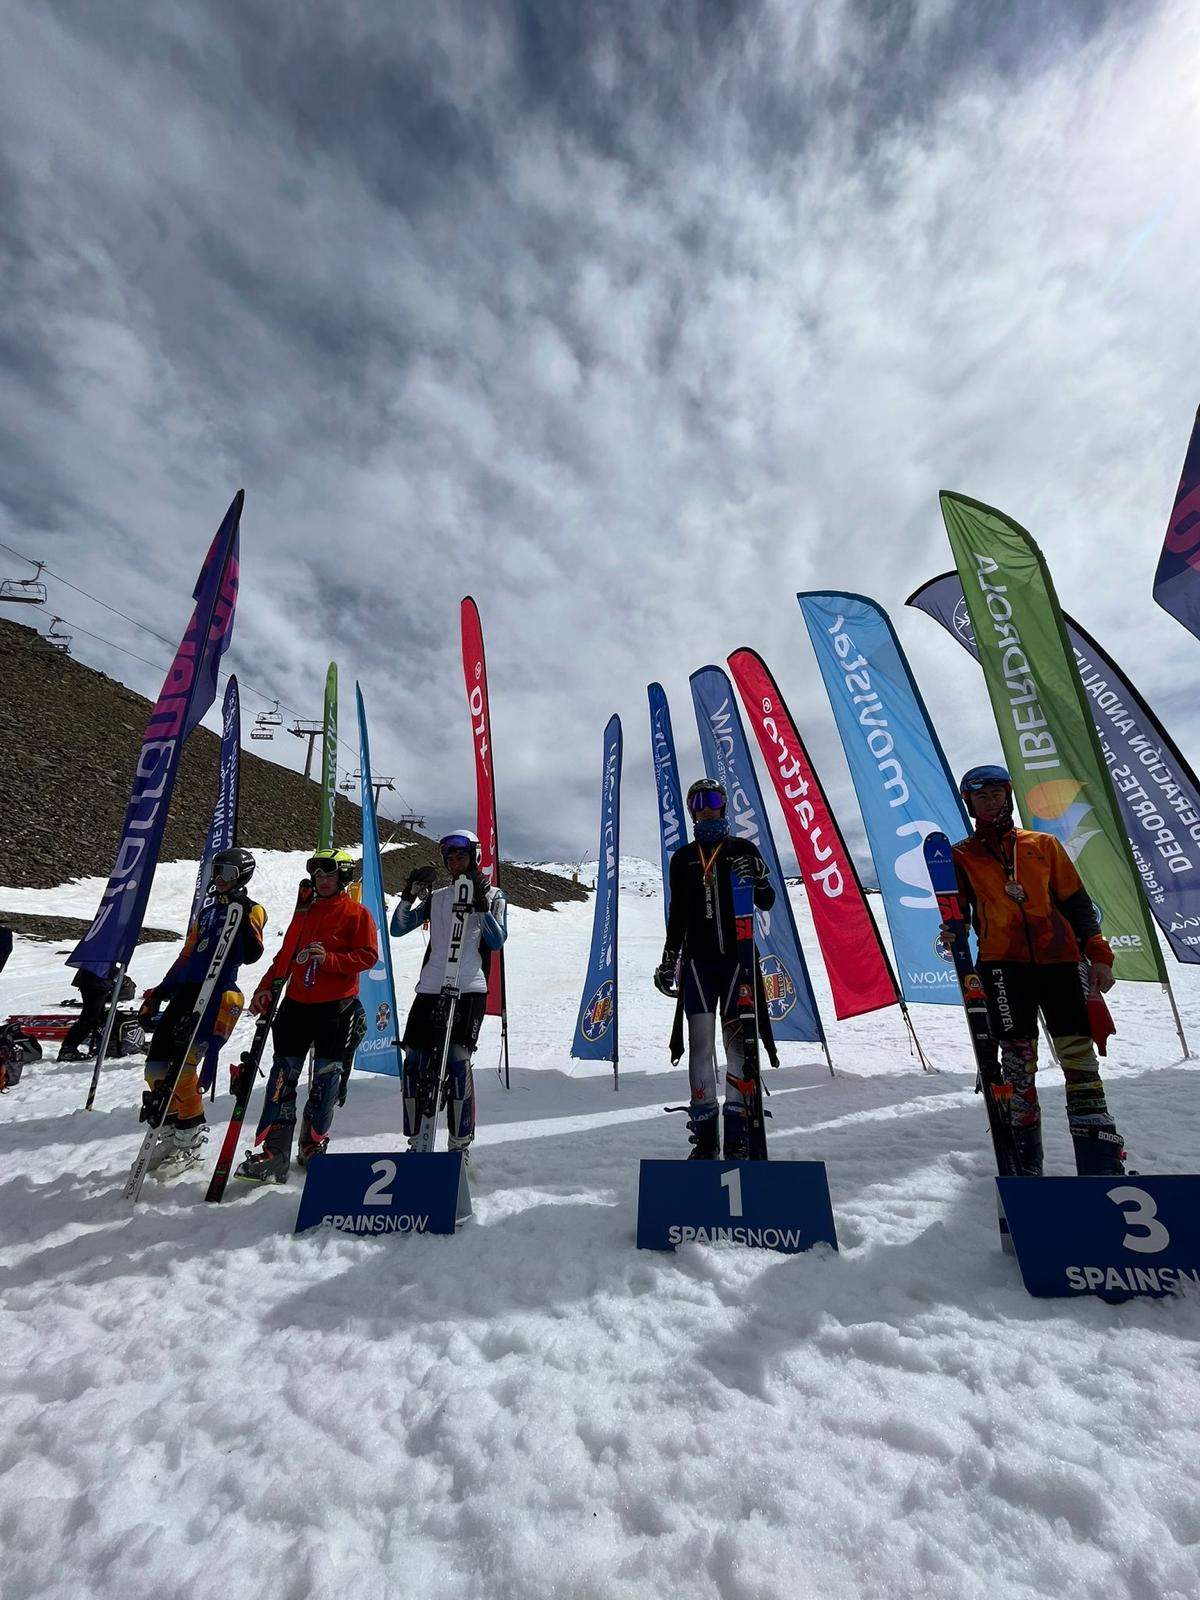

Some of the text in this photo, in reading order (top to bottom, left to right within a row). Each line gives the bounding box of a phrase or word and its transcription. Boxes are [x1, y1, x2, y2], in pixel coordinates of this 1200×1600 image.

[207, 908, 239, 979] HEAD
[448, 883, 469, 963] HEAD
[363, 1159, 397, 1206] 2
[720, 1168, 743, 1217] 1
[321, 1214, 429, 1232] SPAINSNOW
[668, 1225, 801, 1249] SPAINSNOW
[1106, 1186, 1170, 1254] 3
